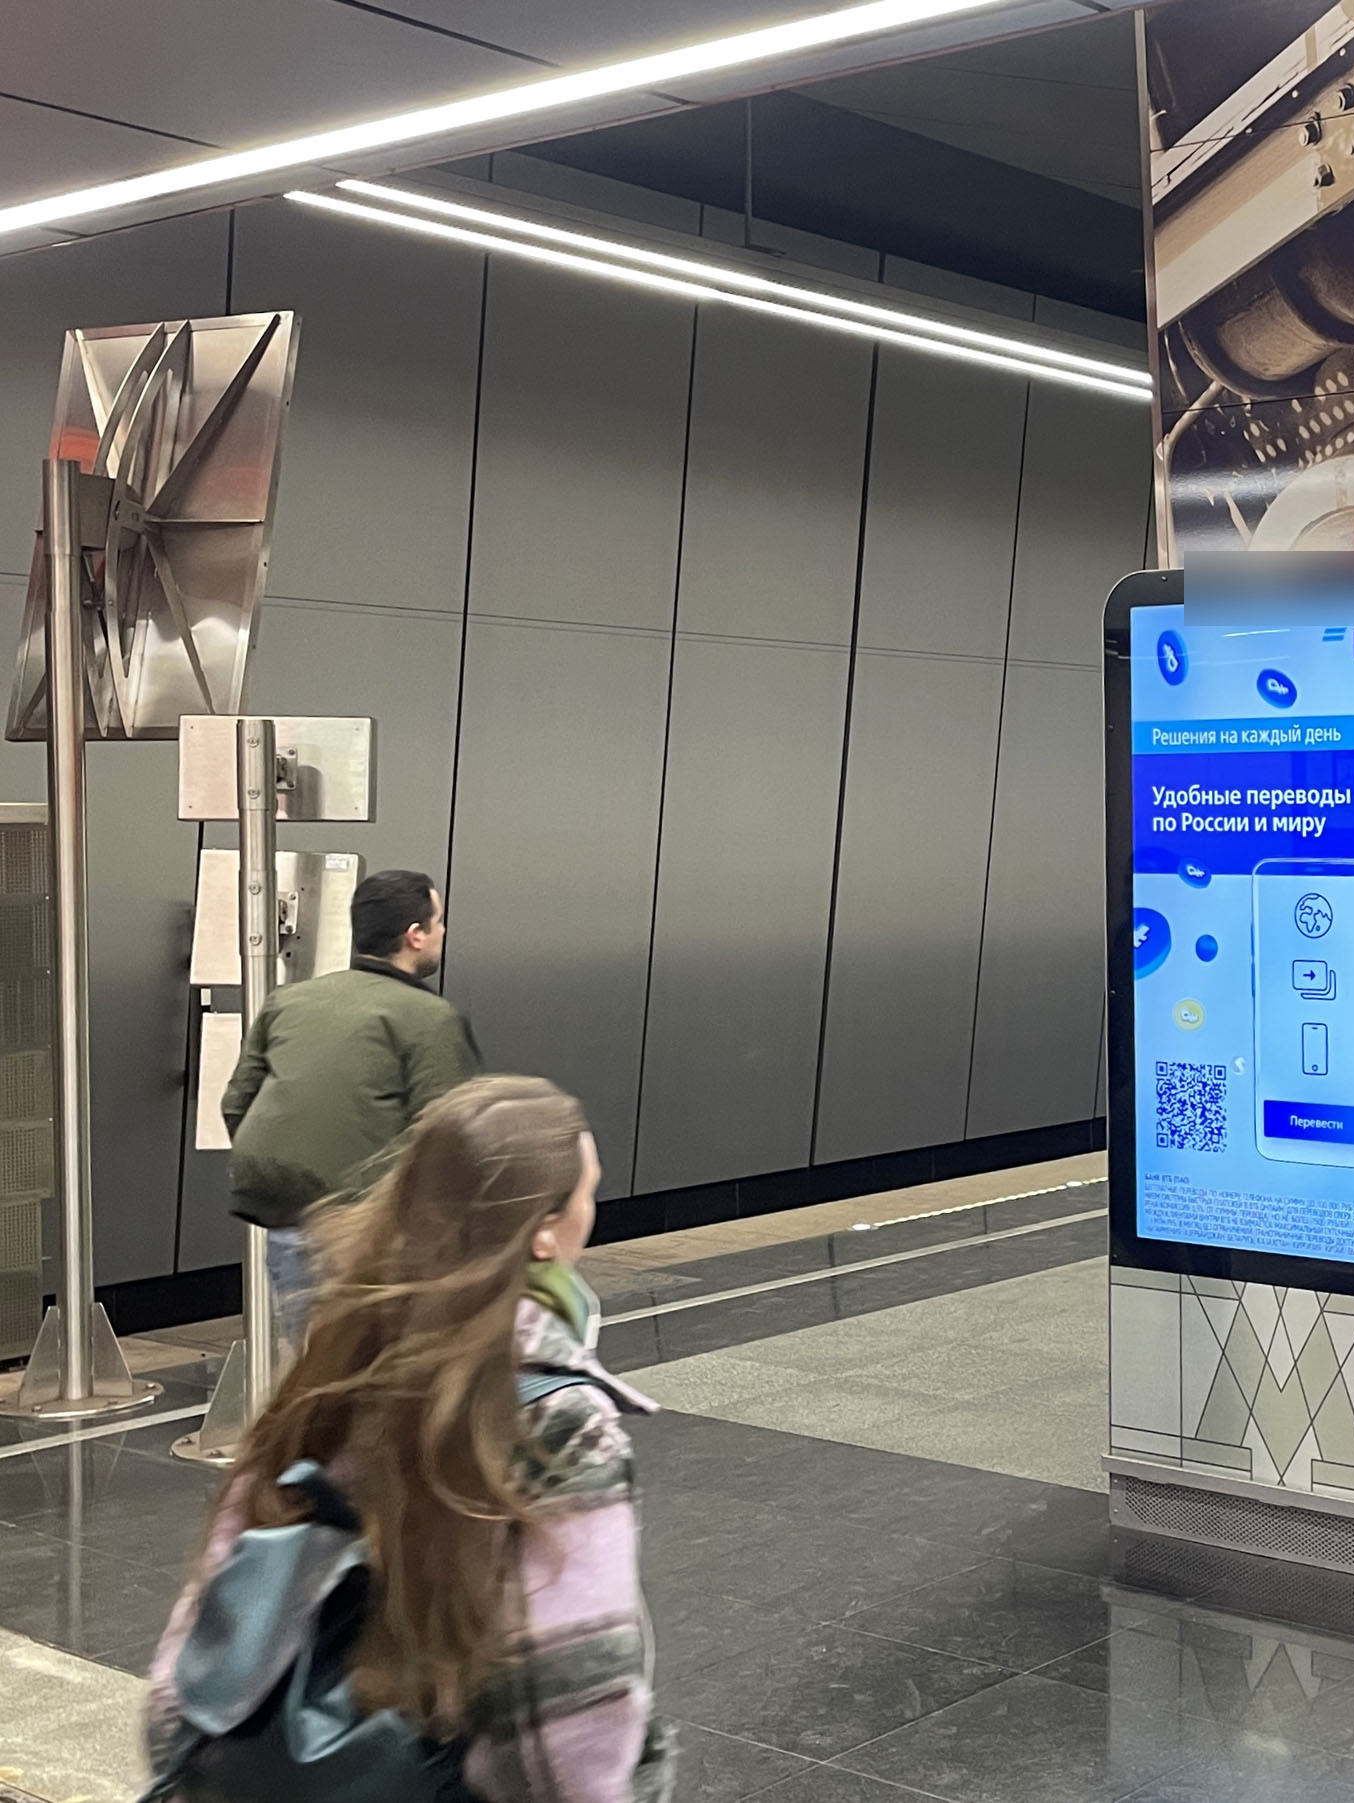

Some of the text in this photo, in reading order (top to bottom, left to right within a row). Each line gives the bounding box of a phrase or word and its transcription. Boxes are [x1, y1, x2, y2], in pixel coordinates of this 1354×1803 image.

[1152, 724, 1342, 746] Решения на каждый день
[1152, 784, 1351, 810] Удобные переводы
[1152, 812, 1326, 838] по России и миру
[1290, 1114, 1344, 1131] Перевести
